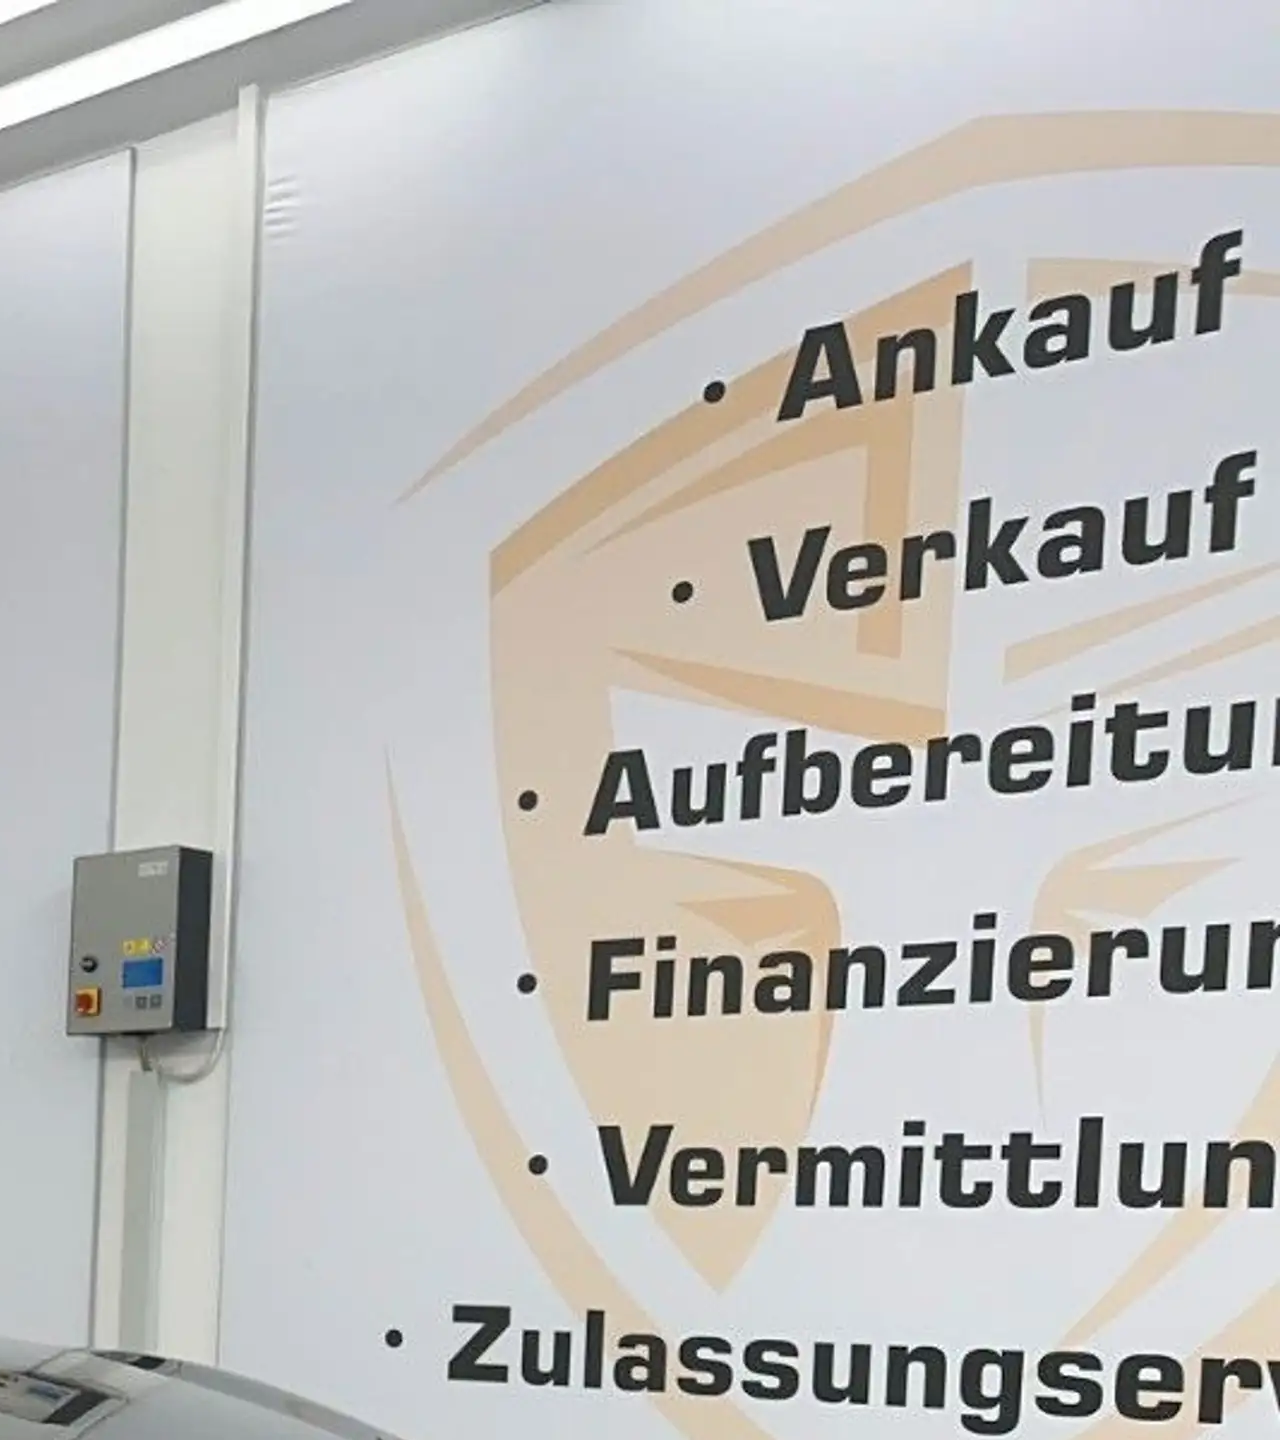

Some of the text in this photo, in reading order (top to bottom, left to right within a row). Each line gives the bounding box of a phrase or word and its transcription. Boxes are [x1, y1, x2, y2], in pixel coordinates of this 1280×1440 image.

[777, 230, 1242, 421] Ankauf
[748, 451, 1256, 621] Verkauf
[584, 693, 1280, 835] Aufbereitu
[598, 1117, 1276, 1209] Vermittlun
[448, 1305, 1280, 1435] Zulassungser
